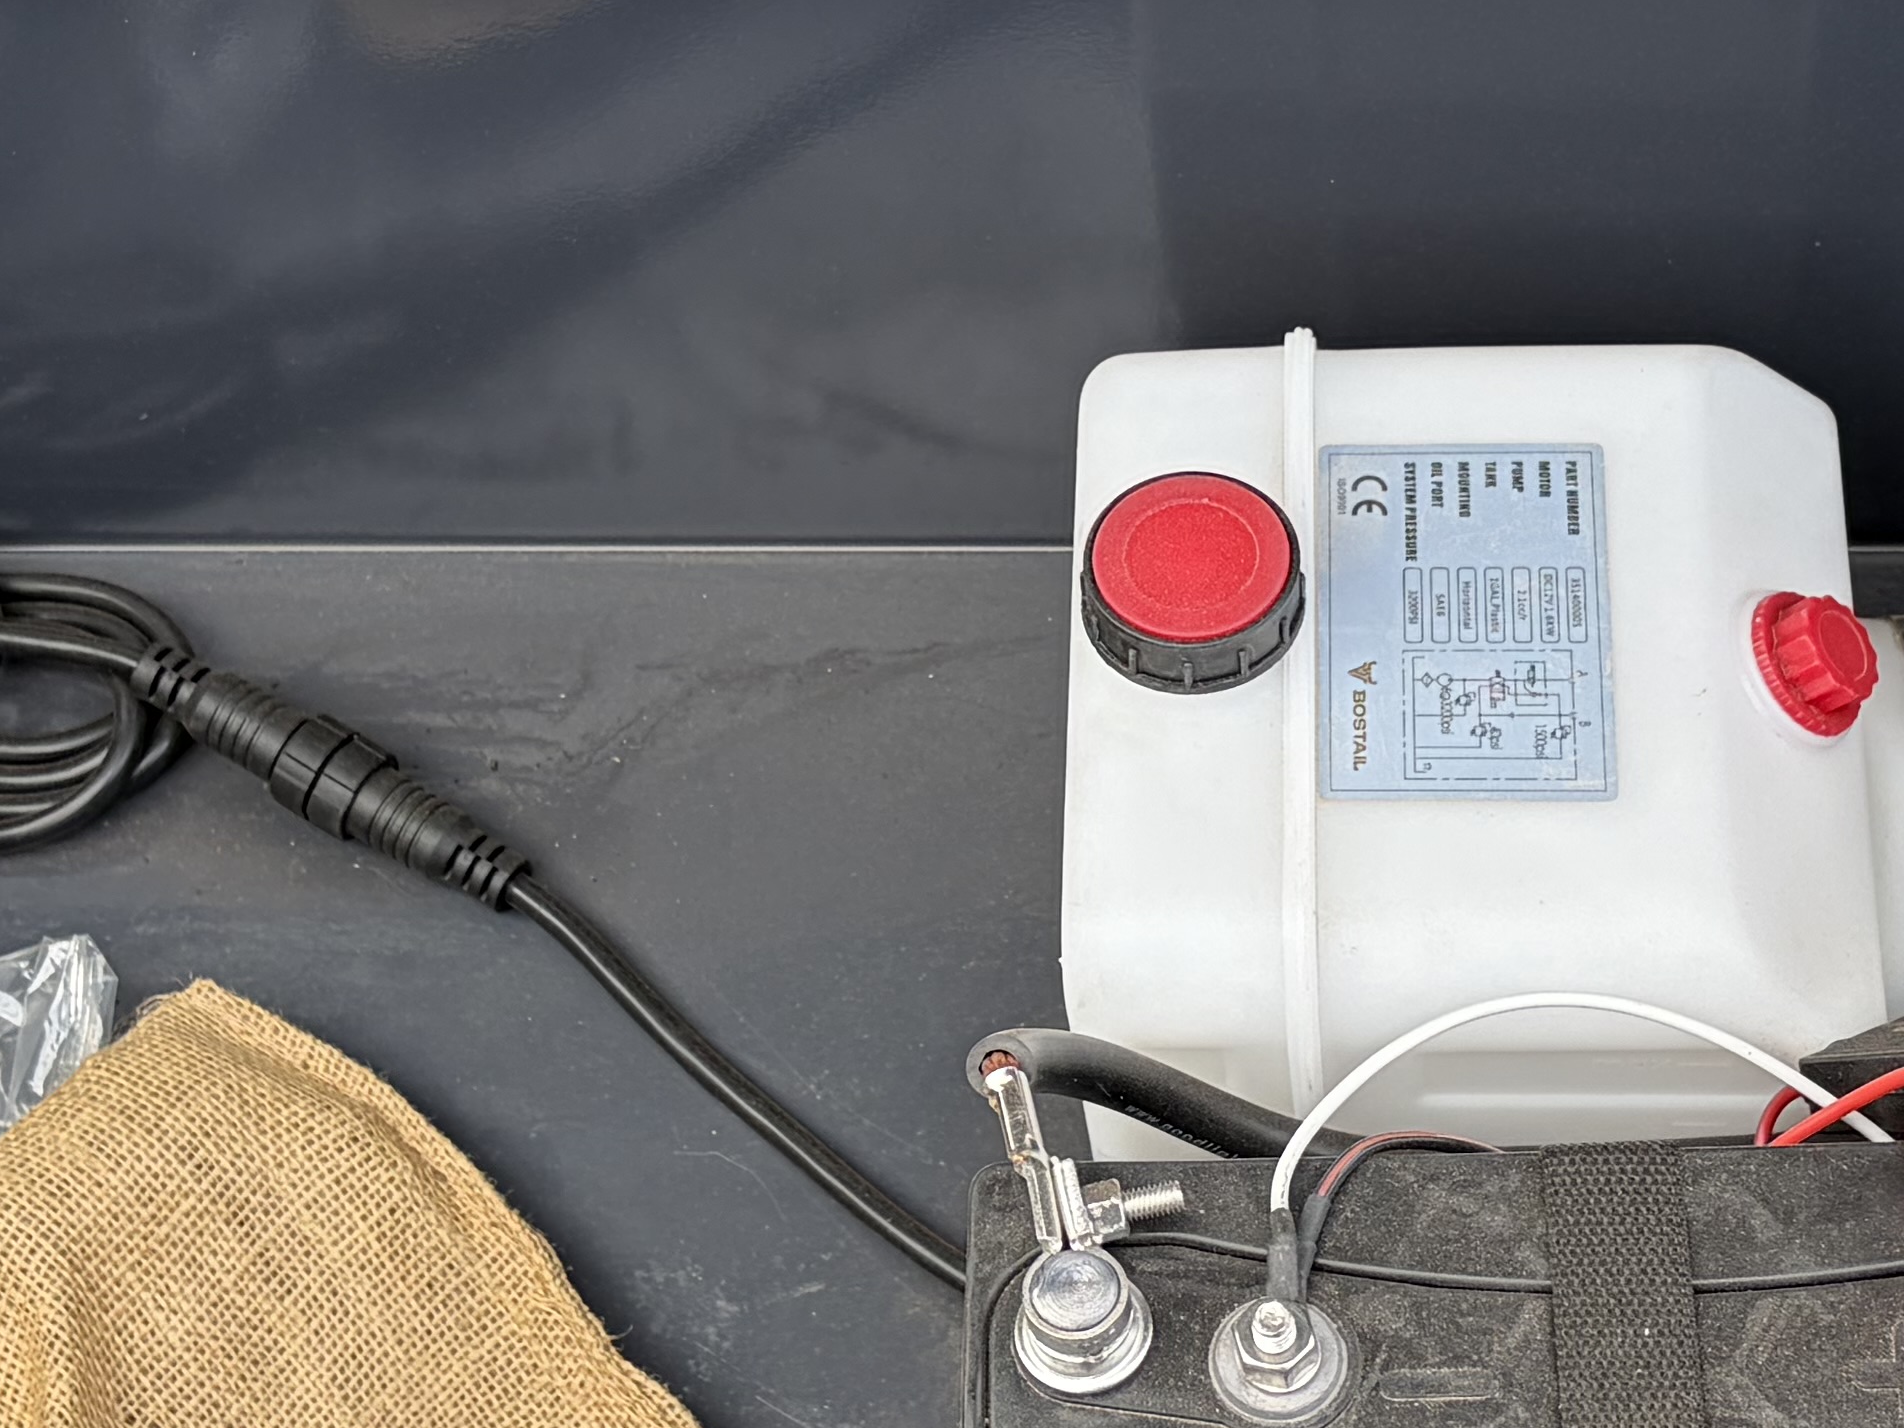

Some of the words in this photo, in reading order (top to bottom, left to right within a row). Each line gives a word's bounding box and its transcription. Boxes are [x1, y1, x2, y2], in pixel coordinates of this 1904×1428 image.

[1404, 462, 1417, 504] SYSTEM
[1432, 482, 1444, 508] PORT
[1458, 461, 1471, 518] MOUNTING
[1511, 461, 1524, 493] PUMP
[1539, 461, 1551, 498] MOTOR
[1565, 461, 1577, 489] PART
[1405, 506, 1418, 562] PRESSURE
[1567, 491, 1580, 536] NUMBER
[1462, 580, 1473, 630] Horizontal
[1352, 690, 1368, 771] BOSTAIL
